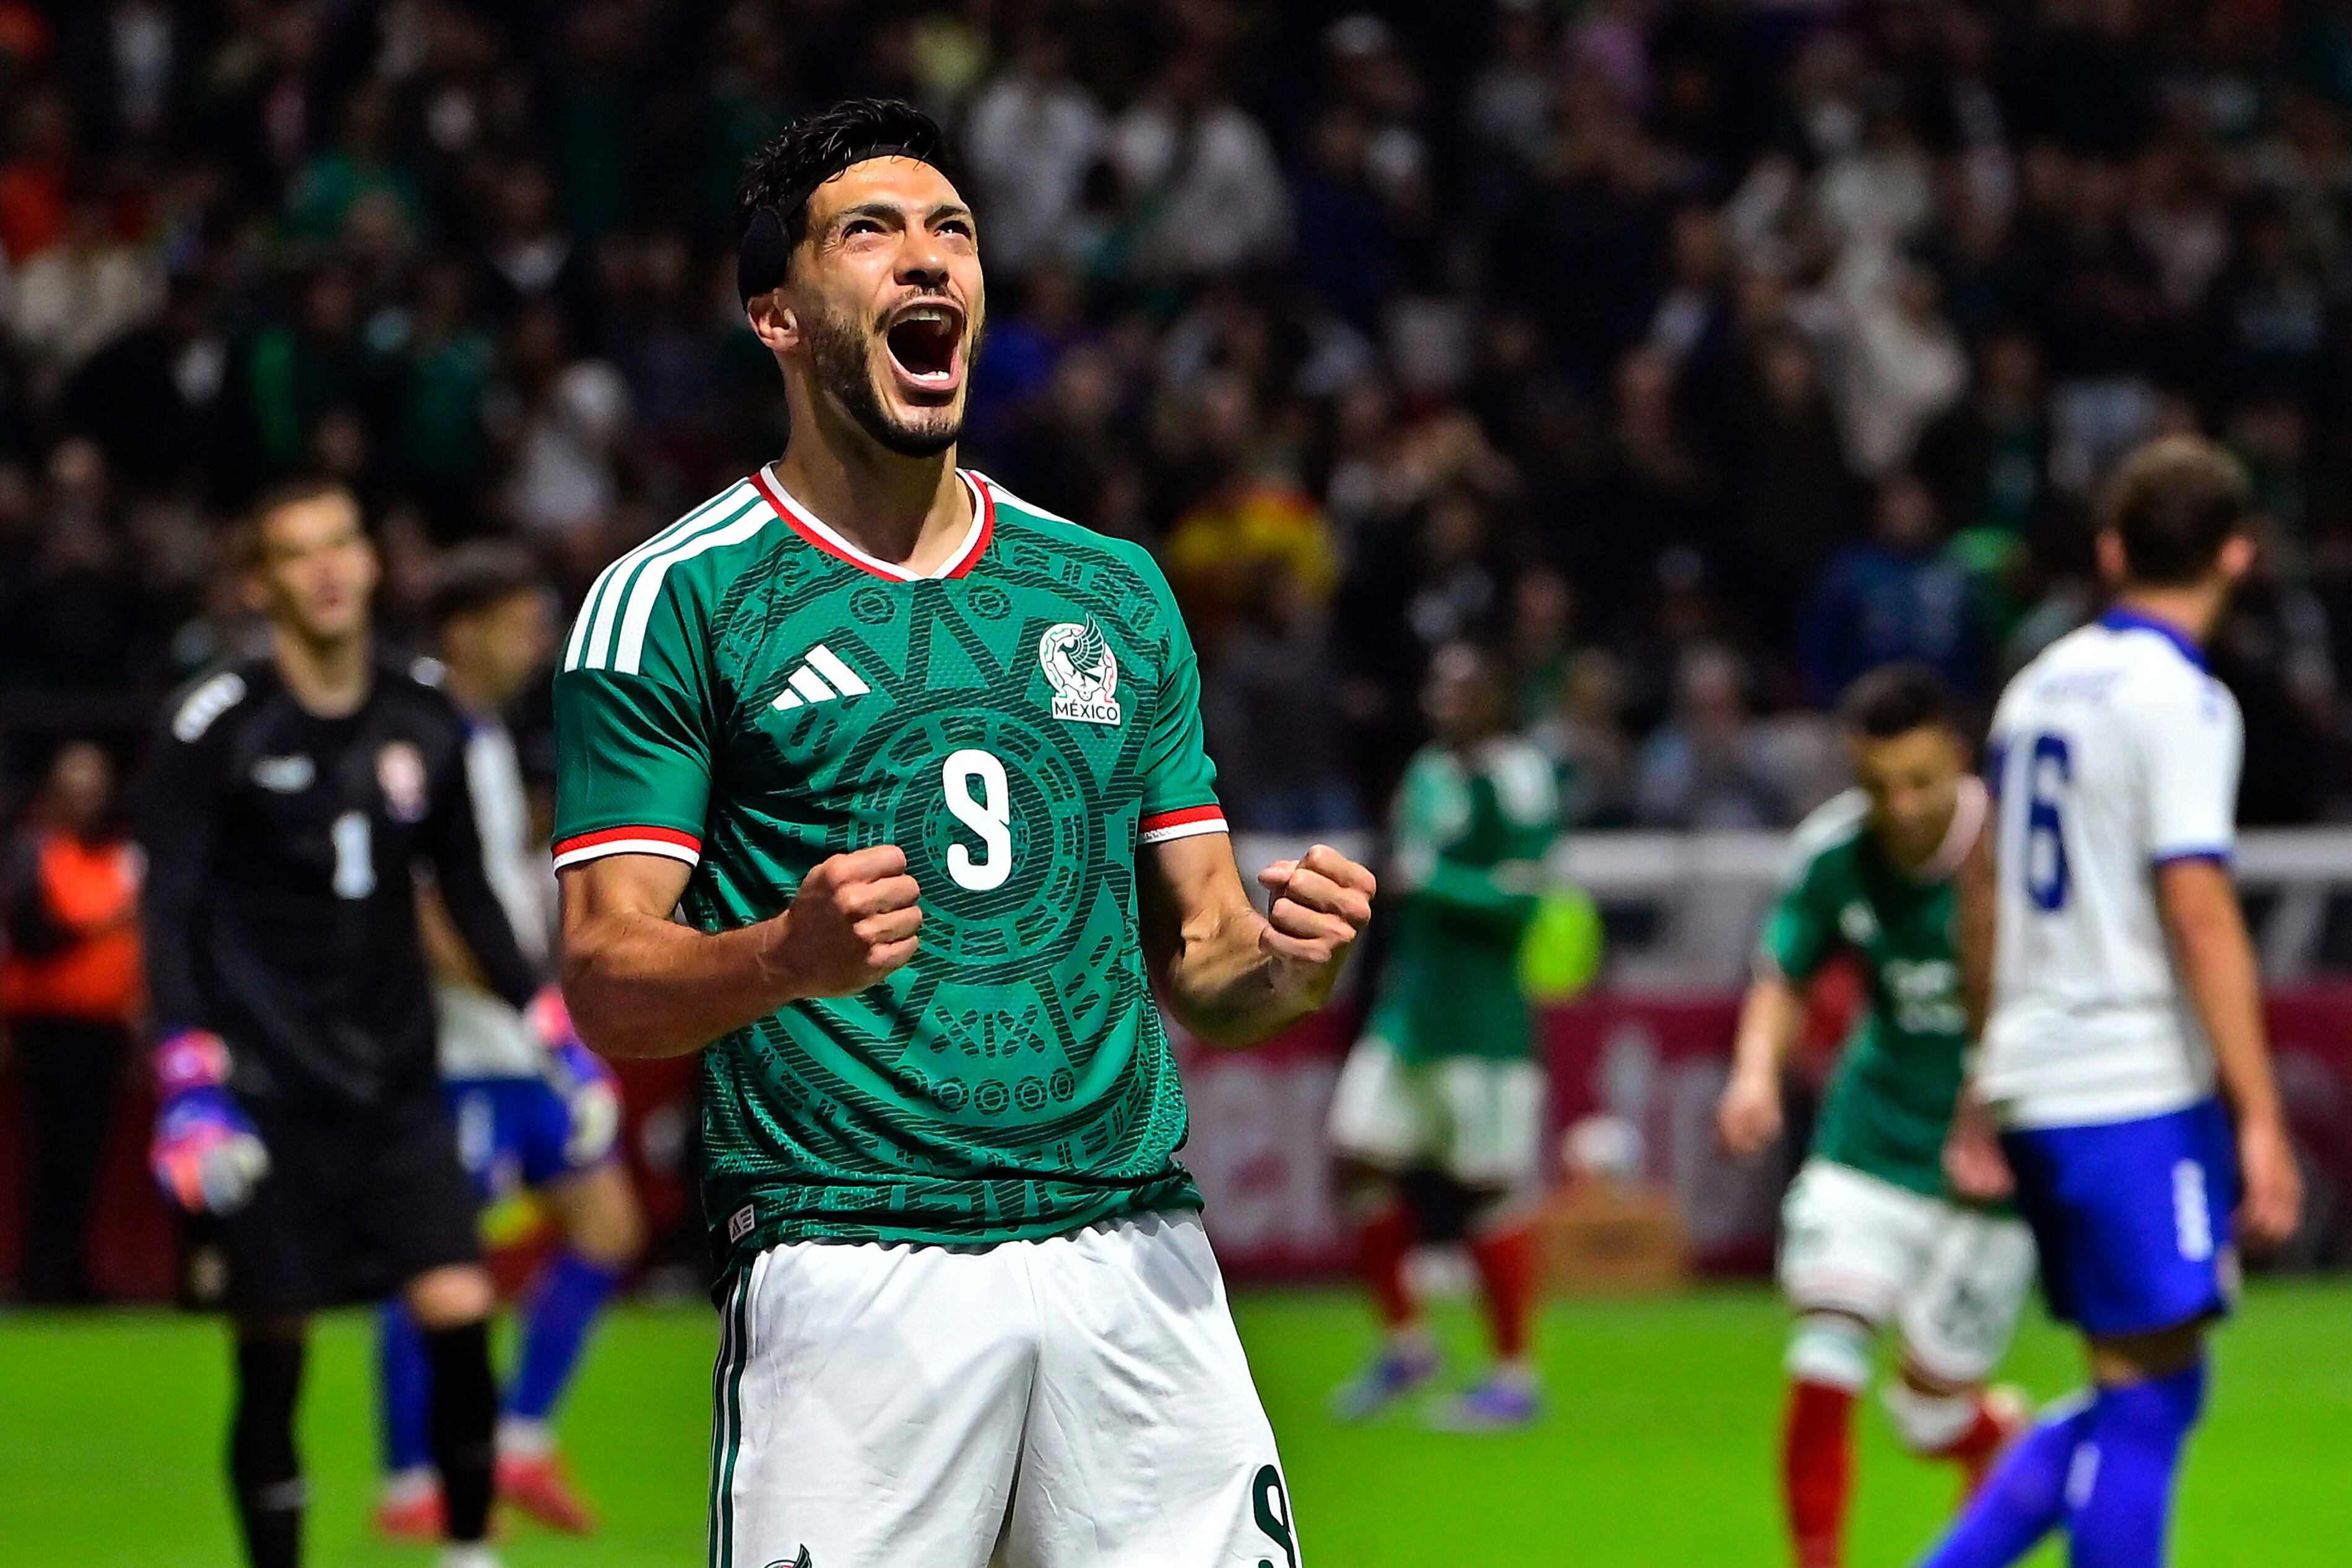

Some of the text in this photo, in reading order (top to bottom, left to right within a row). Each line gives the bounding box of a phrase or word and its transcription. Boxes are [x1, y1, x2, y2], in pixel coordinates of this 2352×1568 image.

[1055, 699, 1118, 721] MÉXICO
[331, 809, 378, 900] 1
[941, 749, 1013, 891] 9
